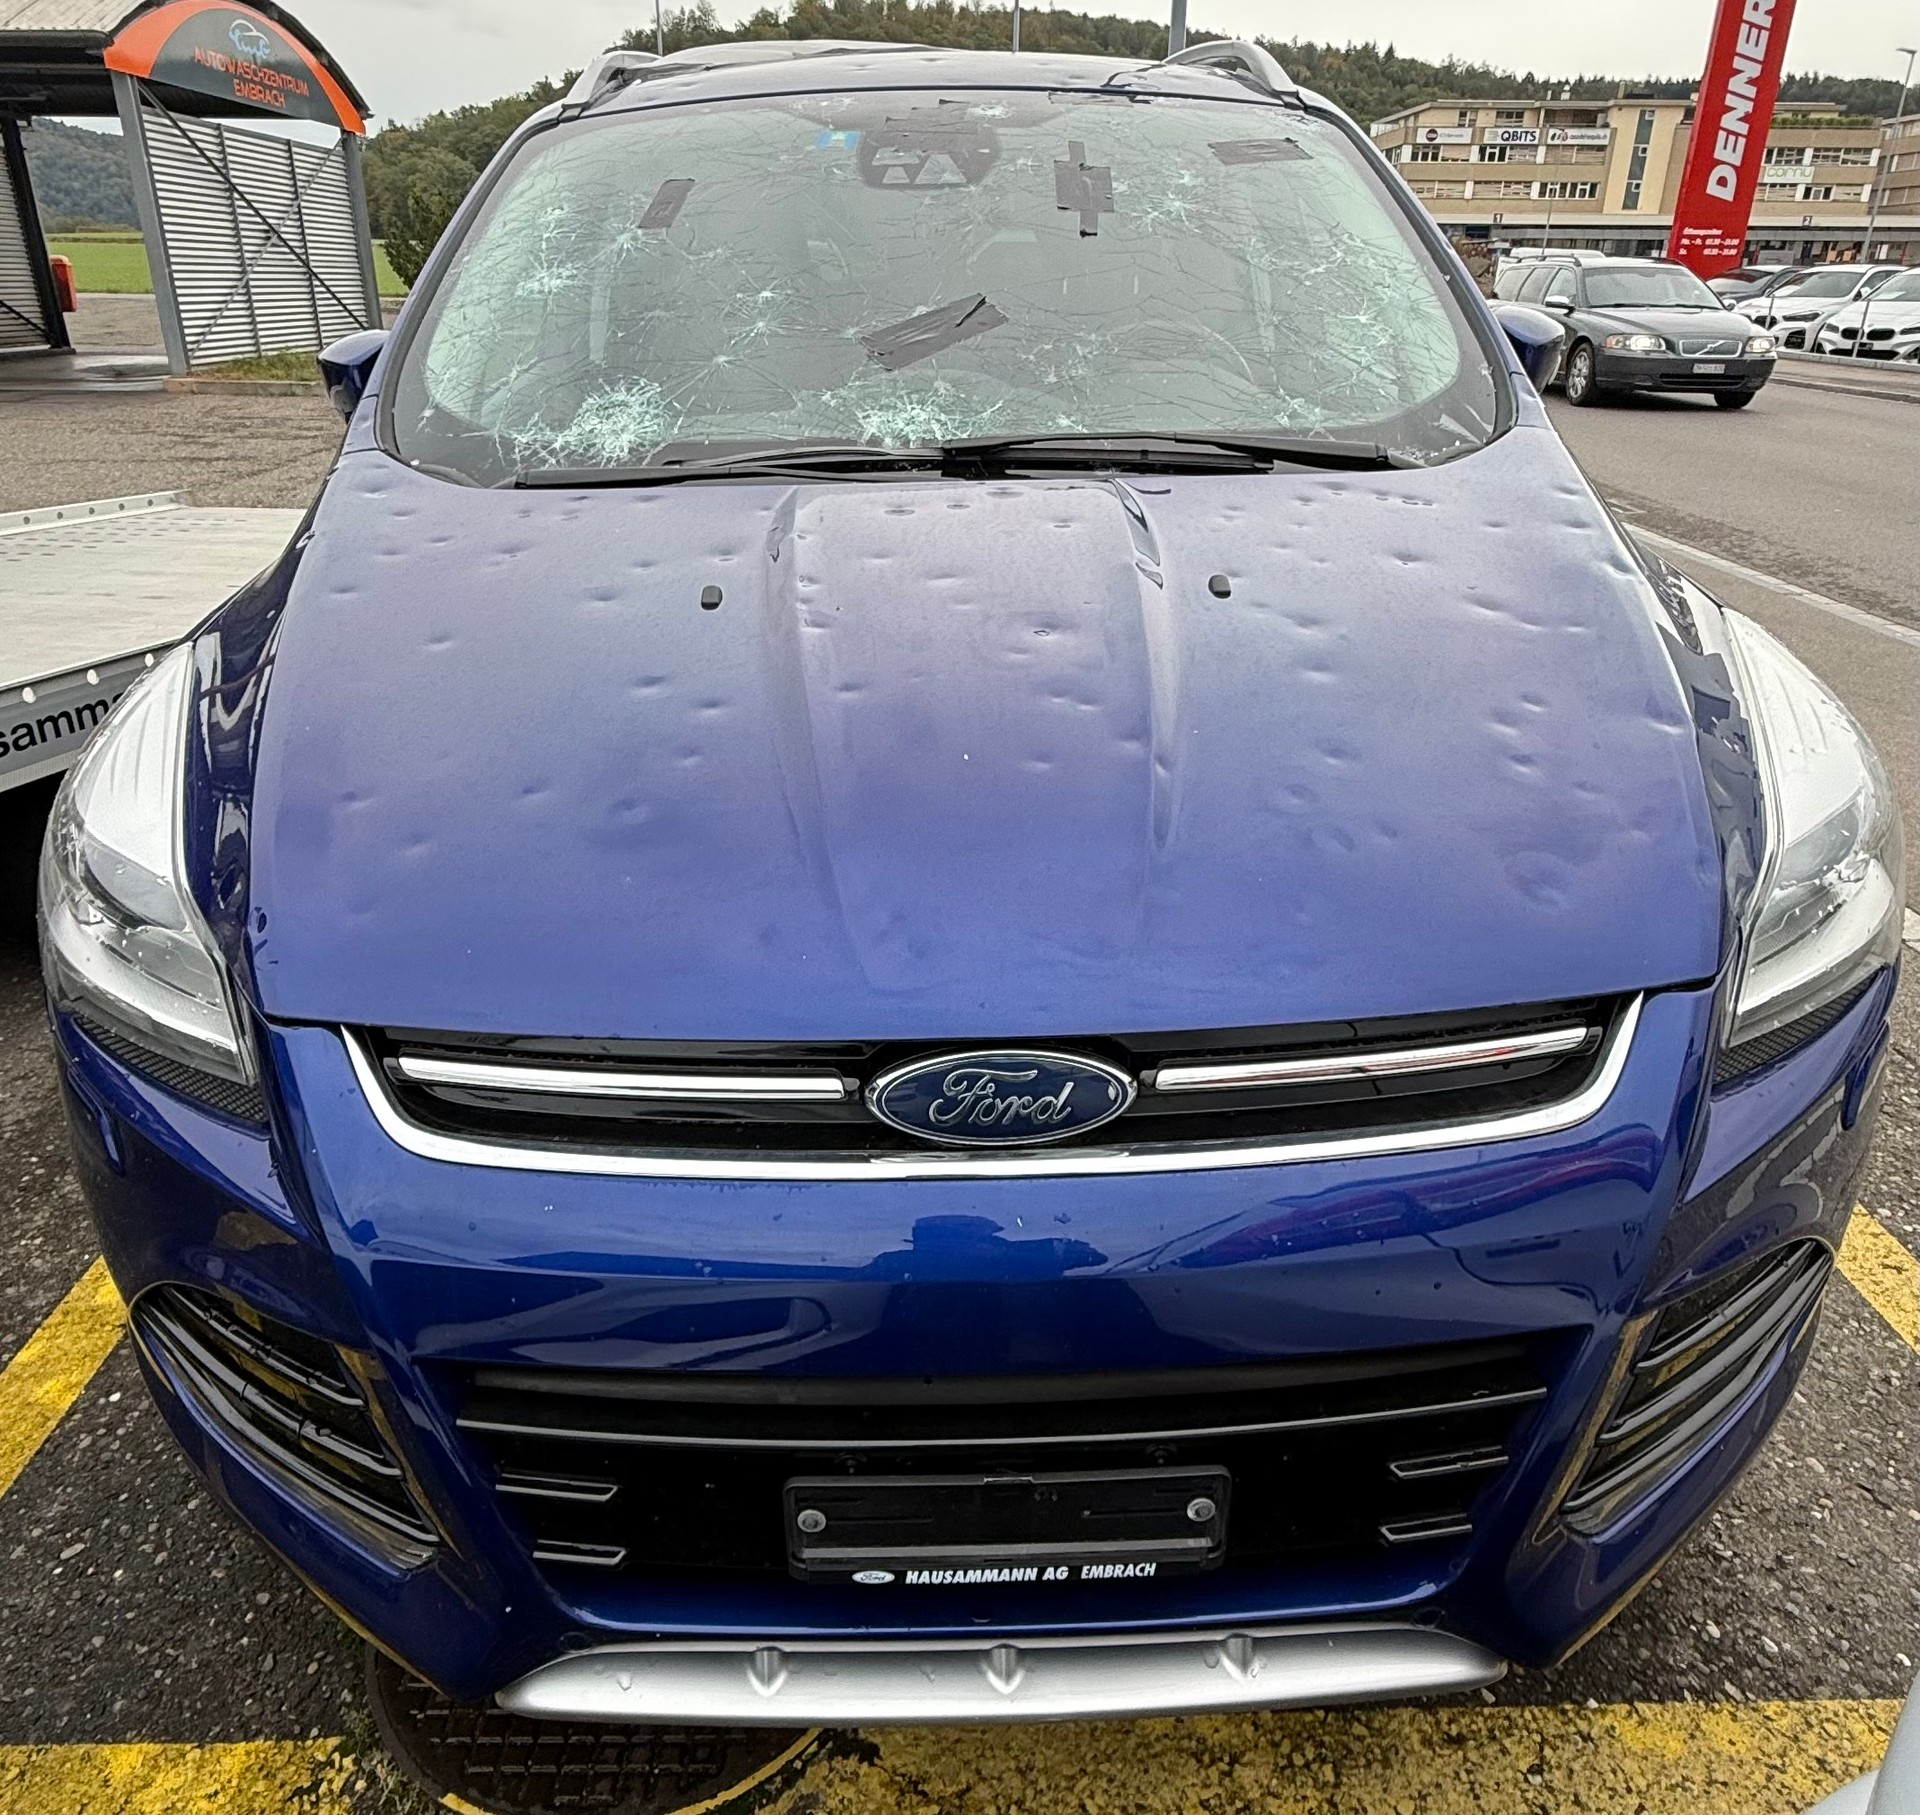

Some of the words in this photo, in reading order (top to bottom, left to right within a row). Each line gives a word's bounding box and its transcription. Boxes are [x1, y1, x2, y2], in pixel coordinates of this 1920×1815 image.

[194, 47, 310, 96] AUTOWASCHZENTRUM
[232, 78, 286, 108] EMBRACH
[1706, 0, 1776, 201] DENNER
[1501, 130, 1537, 142] QBITS
[0, 692, 123, 758] amm
[929, 1069, 1074, 1126] Ford
[905, 1567, 1037, 1584] HAUSAMMANN
[1042, 1566, 1069, 1581] AG
[1081, 1563, 1156, 1580] EMBRACH
